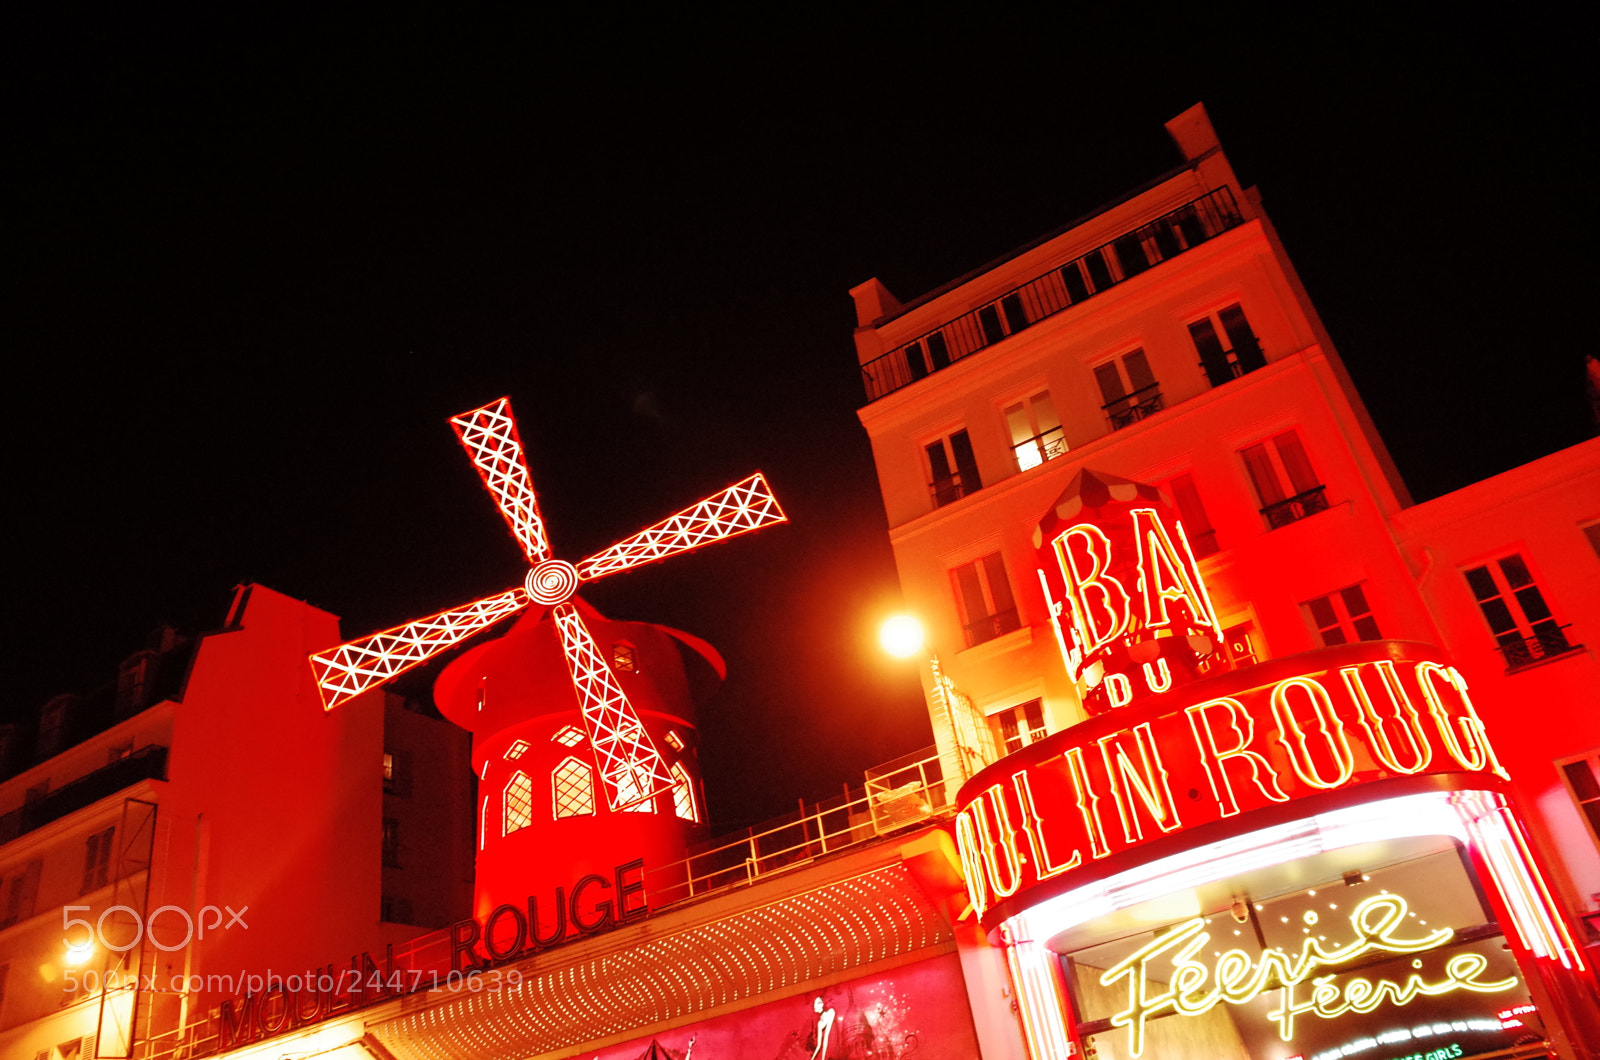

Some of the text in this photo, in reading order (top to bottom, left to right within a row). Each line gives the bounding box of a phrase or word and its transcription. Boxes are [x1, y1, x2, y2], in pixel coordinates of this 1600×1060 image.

[1051, 508, 1225, 656] BA
[1104, 658, 1172, 708] DU
[1184, 660, 1511, 819] ROUG
[218, 858, 648, 1050] MOULIN ROUGE
[1100, 893, 1454, 1058] Féerie
